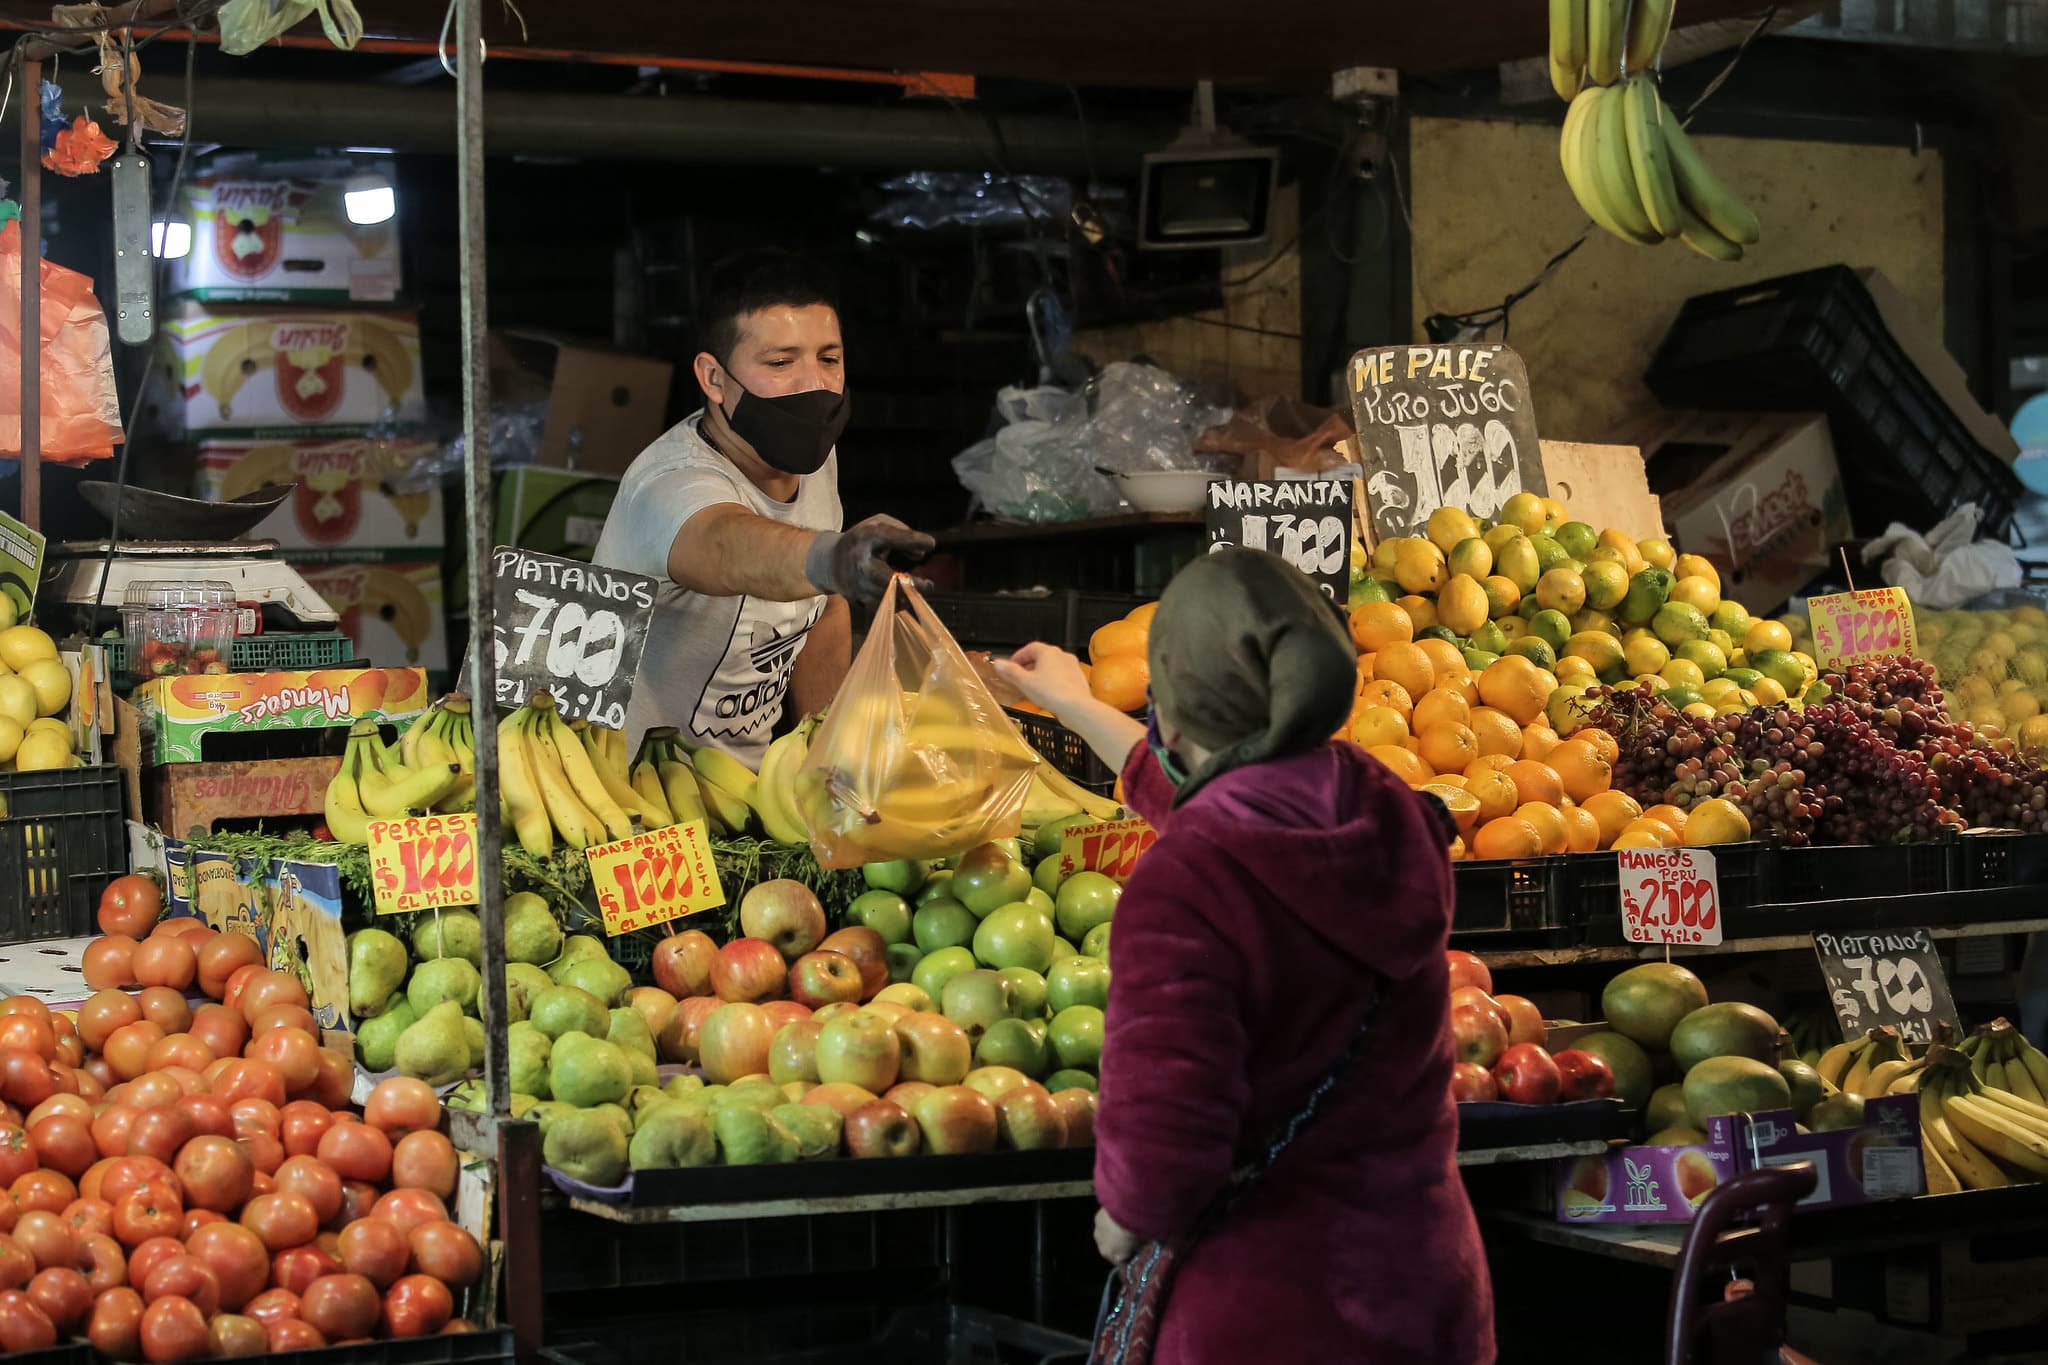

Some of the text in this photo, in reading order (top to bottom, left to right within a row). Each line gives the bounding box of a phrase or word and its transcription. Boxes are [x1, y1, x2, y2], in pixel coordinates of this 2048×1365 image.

[1354, 351, 1395, 393] ME
[1364, 386, 1430, 425] PURO
[1208, 479, 1350, 510] NARANJA
[240, 685, 351, 725] Mangoes
[368, 815, 467, 844] PeRAS
[1618, 849, 1694, 870] MANGOS
[1658, 867, 1697, 882] PeRU
[397, 889, 474, 910] eL KiLO
[620, 903, 690, 932] eL KiLO
[1631, 927, 1703, 944] eL KiLO
[1706, 1151, 1729, 1162] Mango
